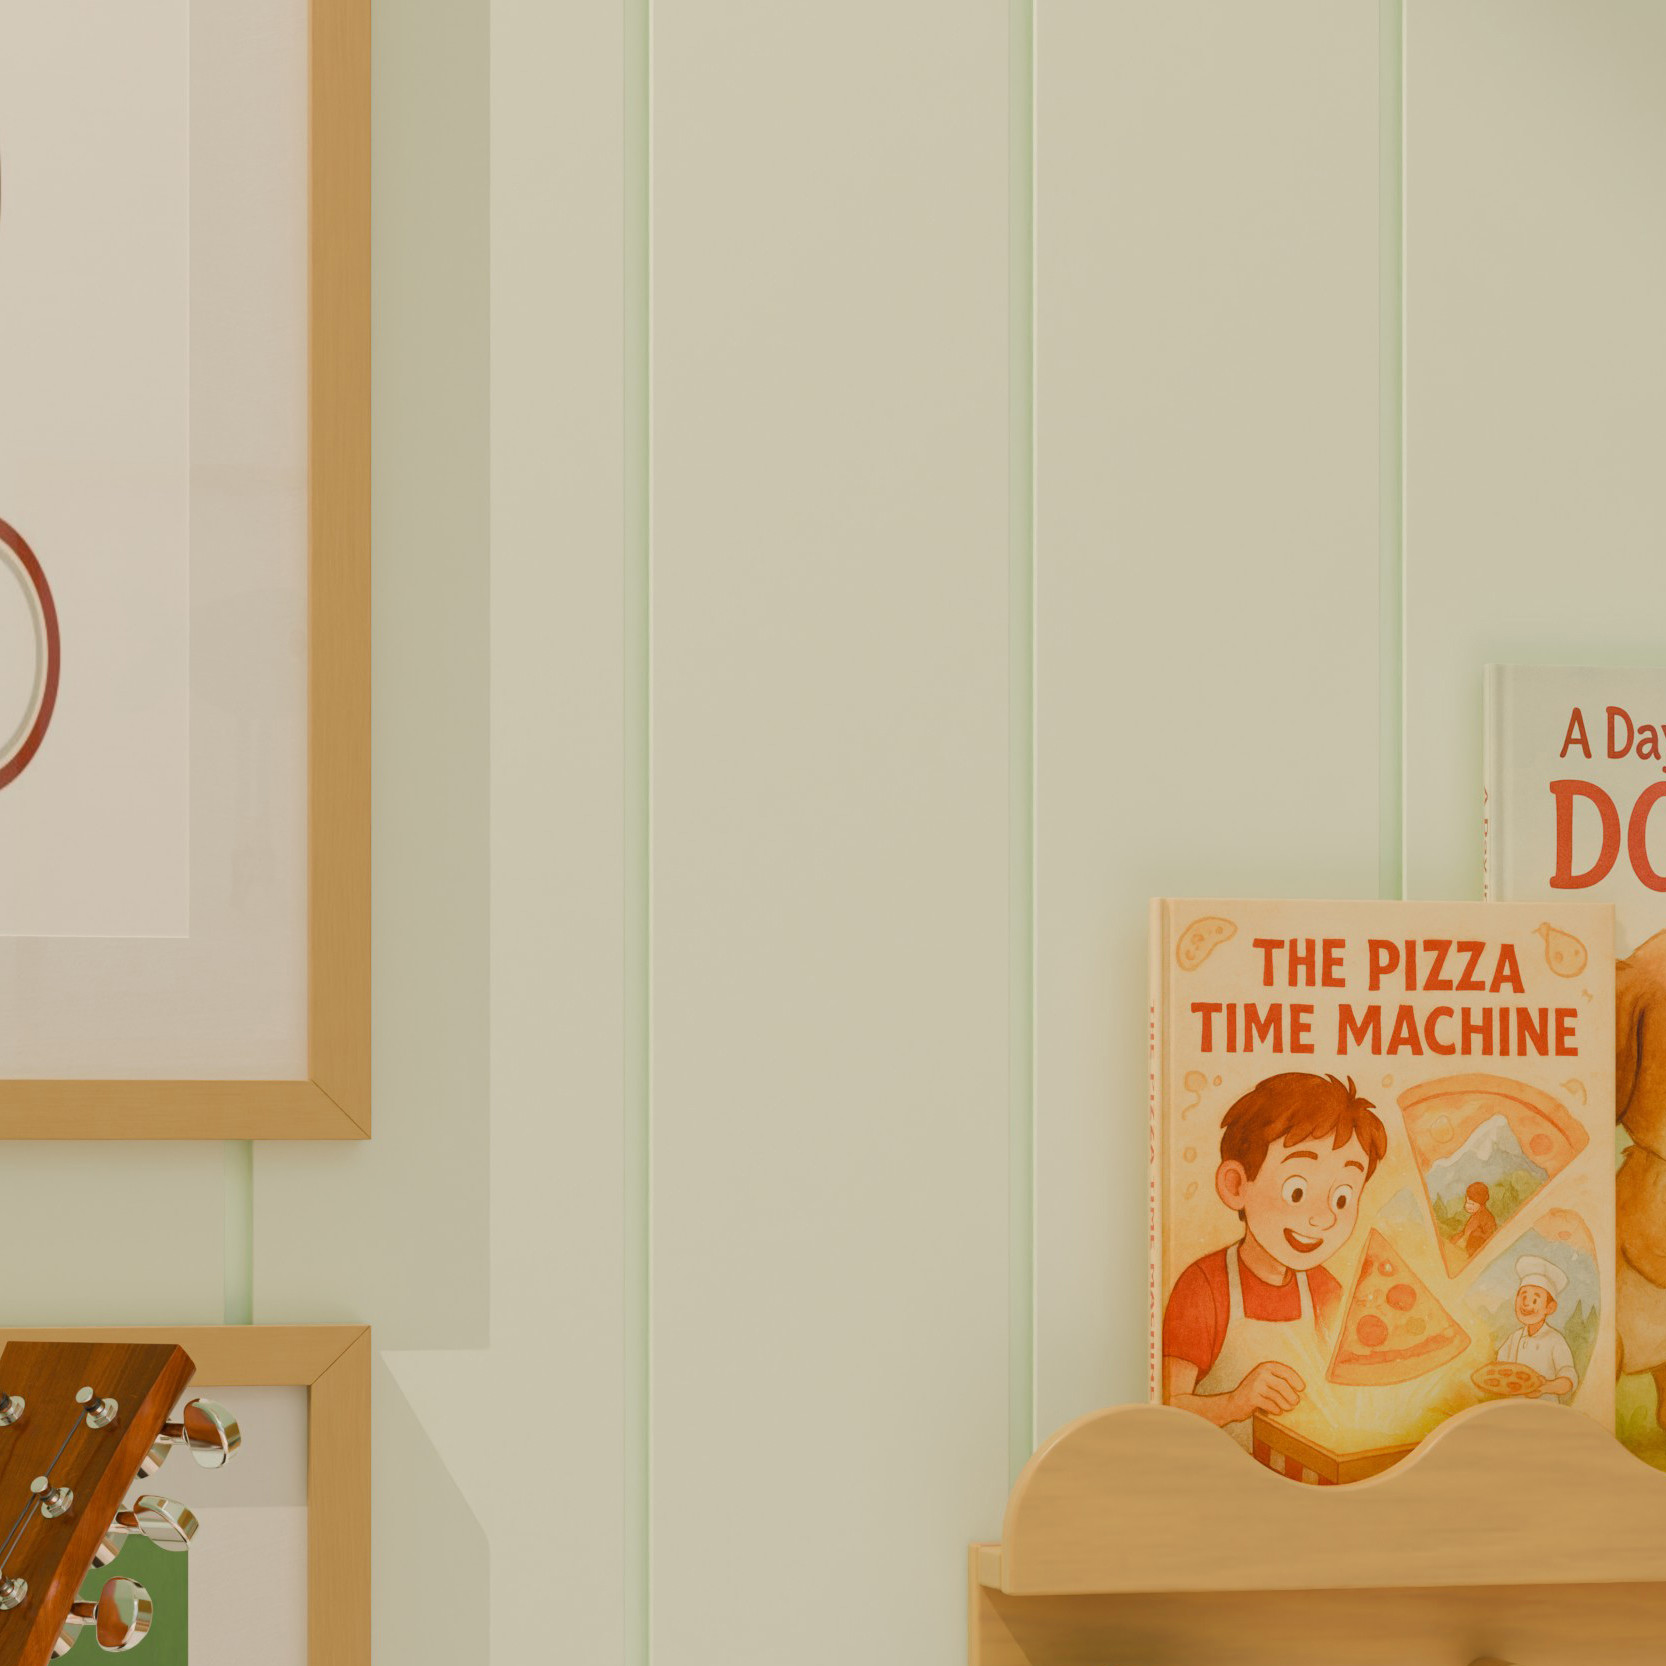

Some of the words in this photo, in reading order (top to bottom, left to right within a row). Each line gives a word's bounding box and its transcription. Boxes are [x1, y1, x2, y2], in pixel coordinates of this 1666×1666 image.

[1560, 706, 1593, 760] A
[1253, 937, 1347, 989] THE
[1368, 940, 1527, 995] PIZZA
[1191, 1002, 1316, 1056] TIME
[1337, 1004, 1580, 1058] MACHINE
